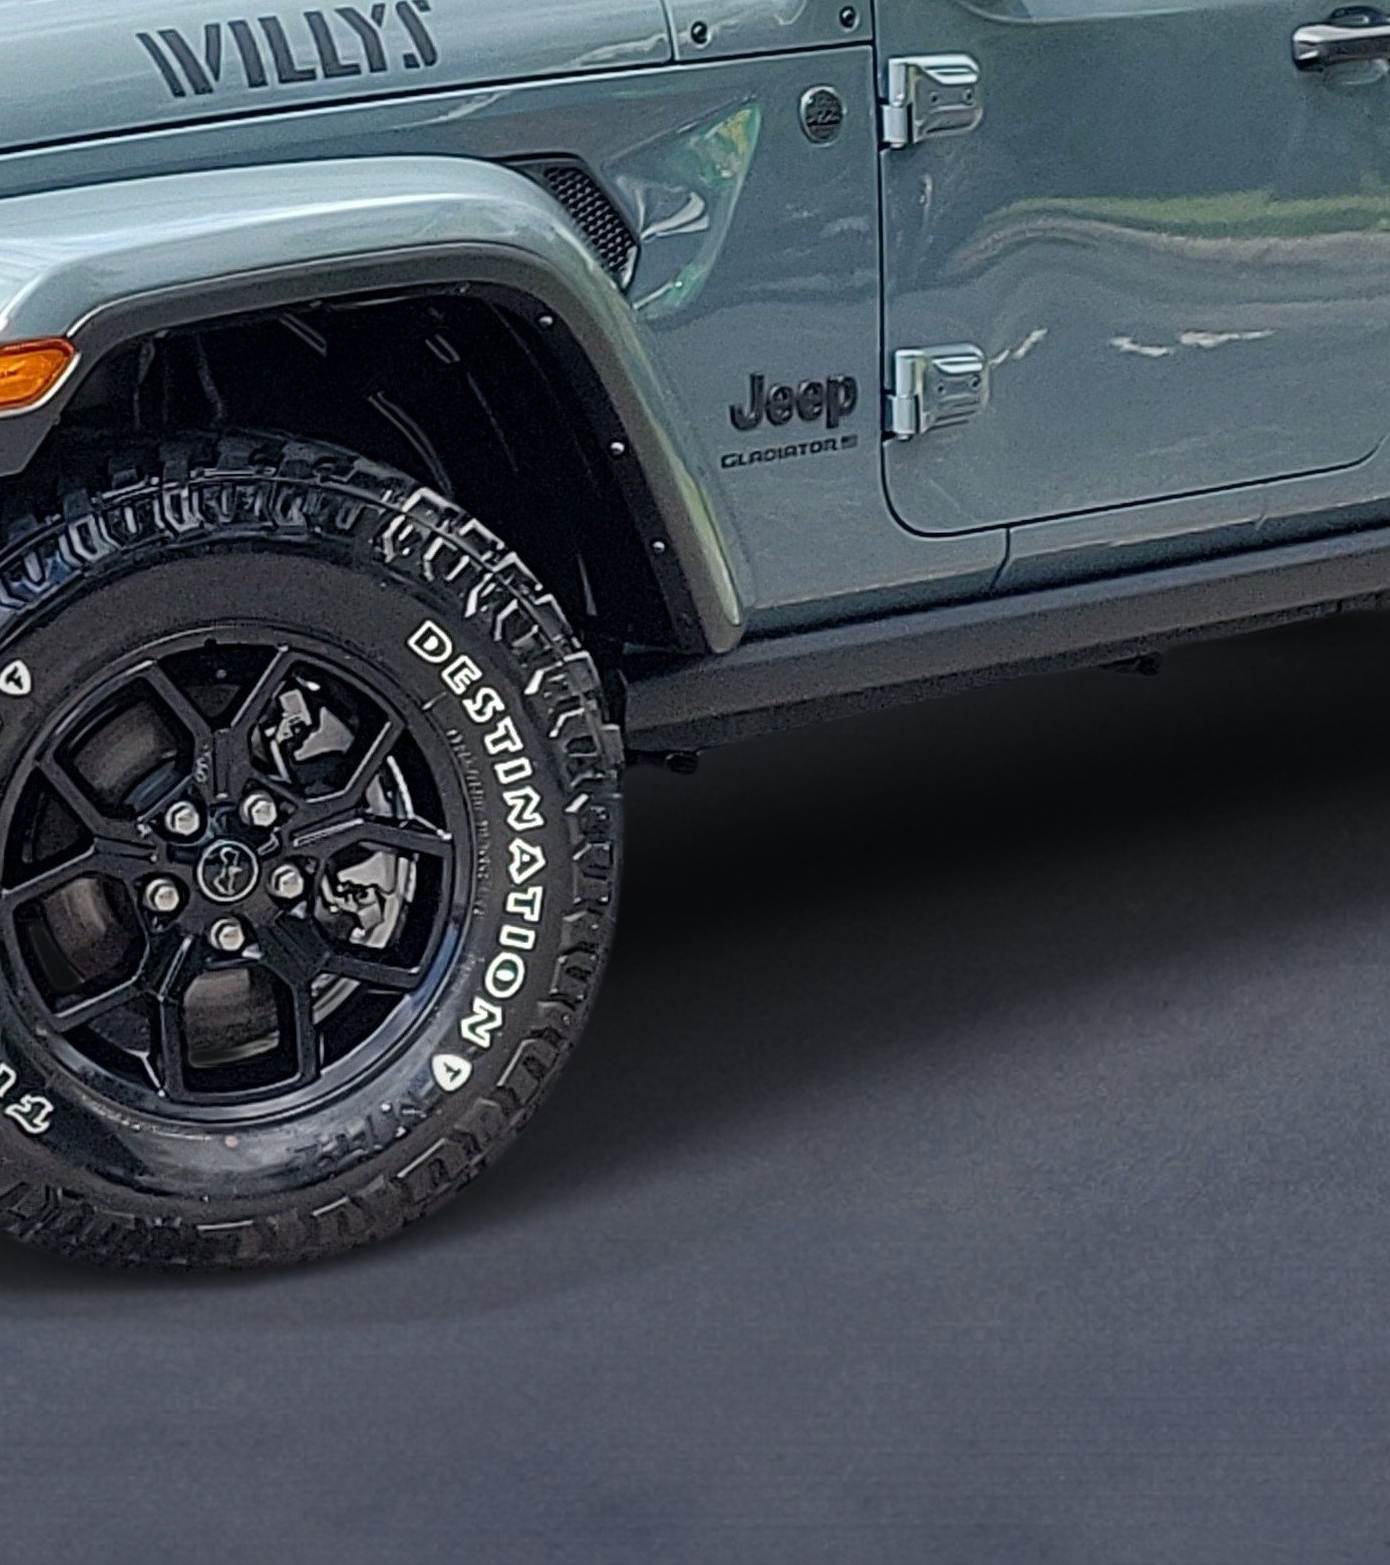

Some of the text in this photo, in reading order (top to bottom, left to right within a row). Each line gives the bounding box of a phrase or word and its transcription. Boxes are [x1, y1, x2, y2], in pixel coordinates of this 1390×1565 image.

[729, 371, 857, 432] Jeep
[721, 436, 838, 469] GLADIATOR
[407, 619, 546, 1049] DESTINATION
